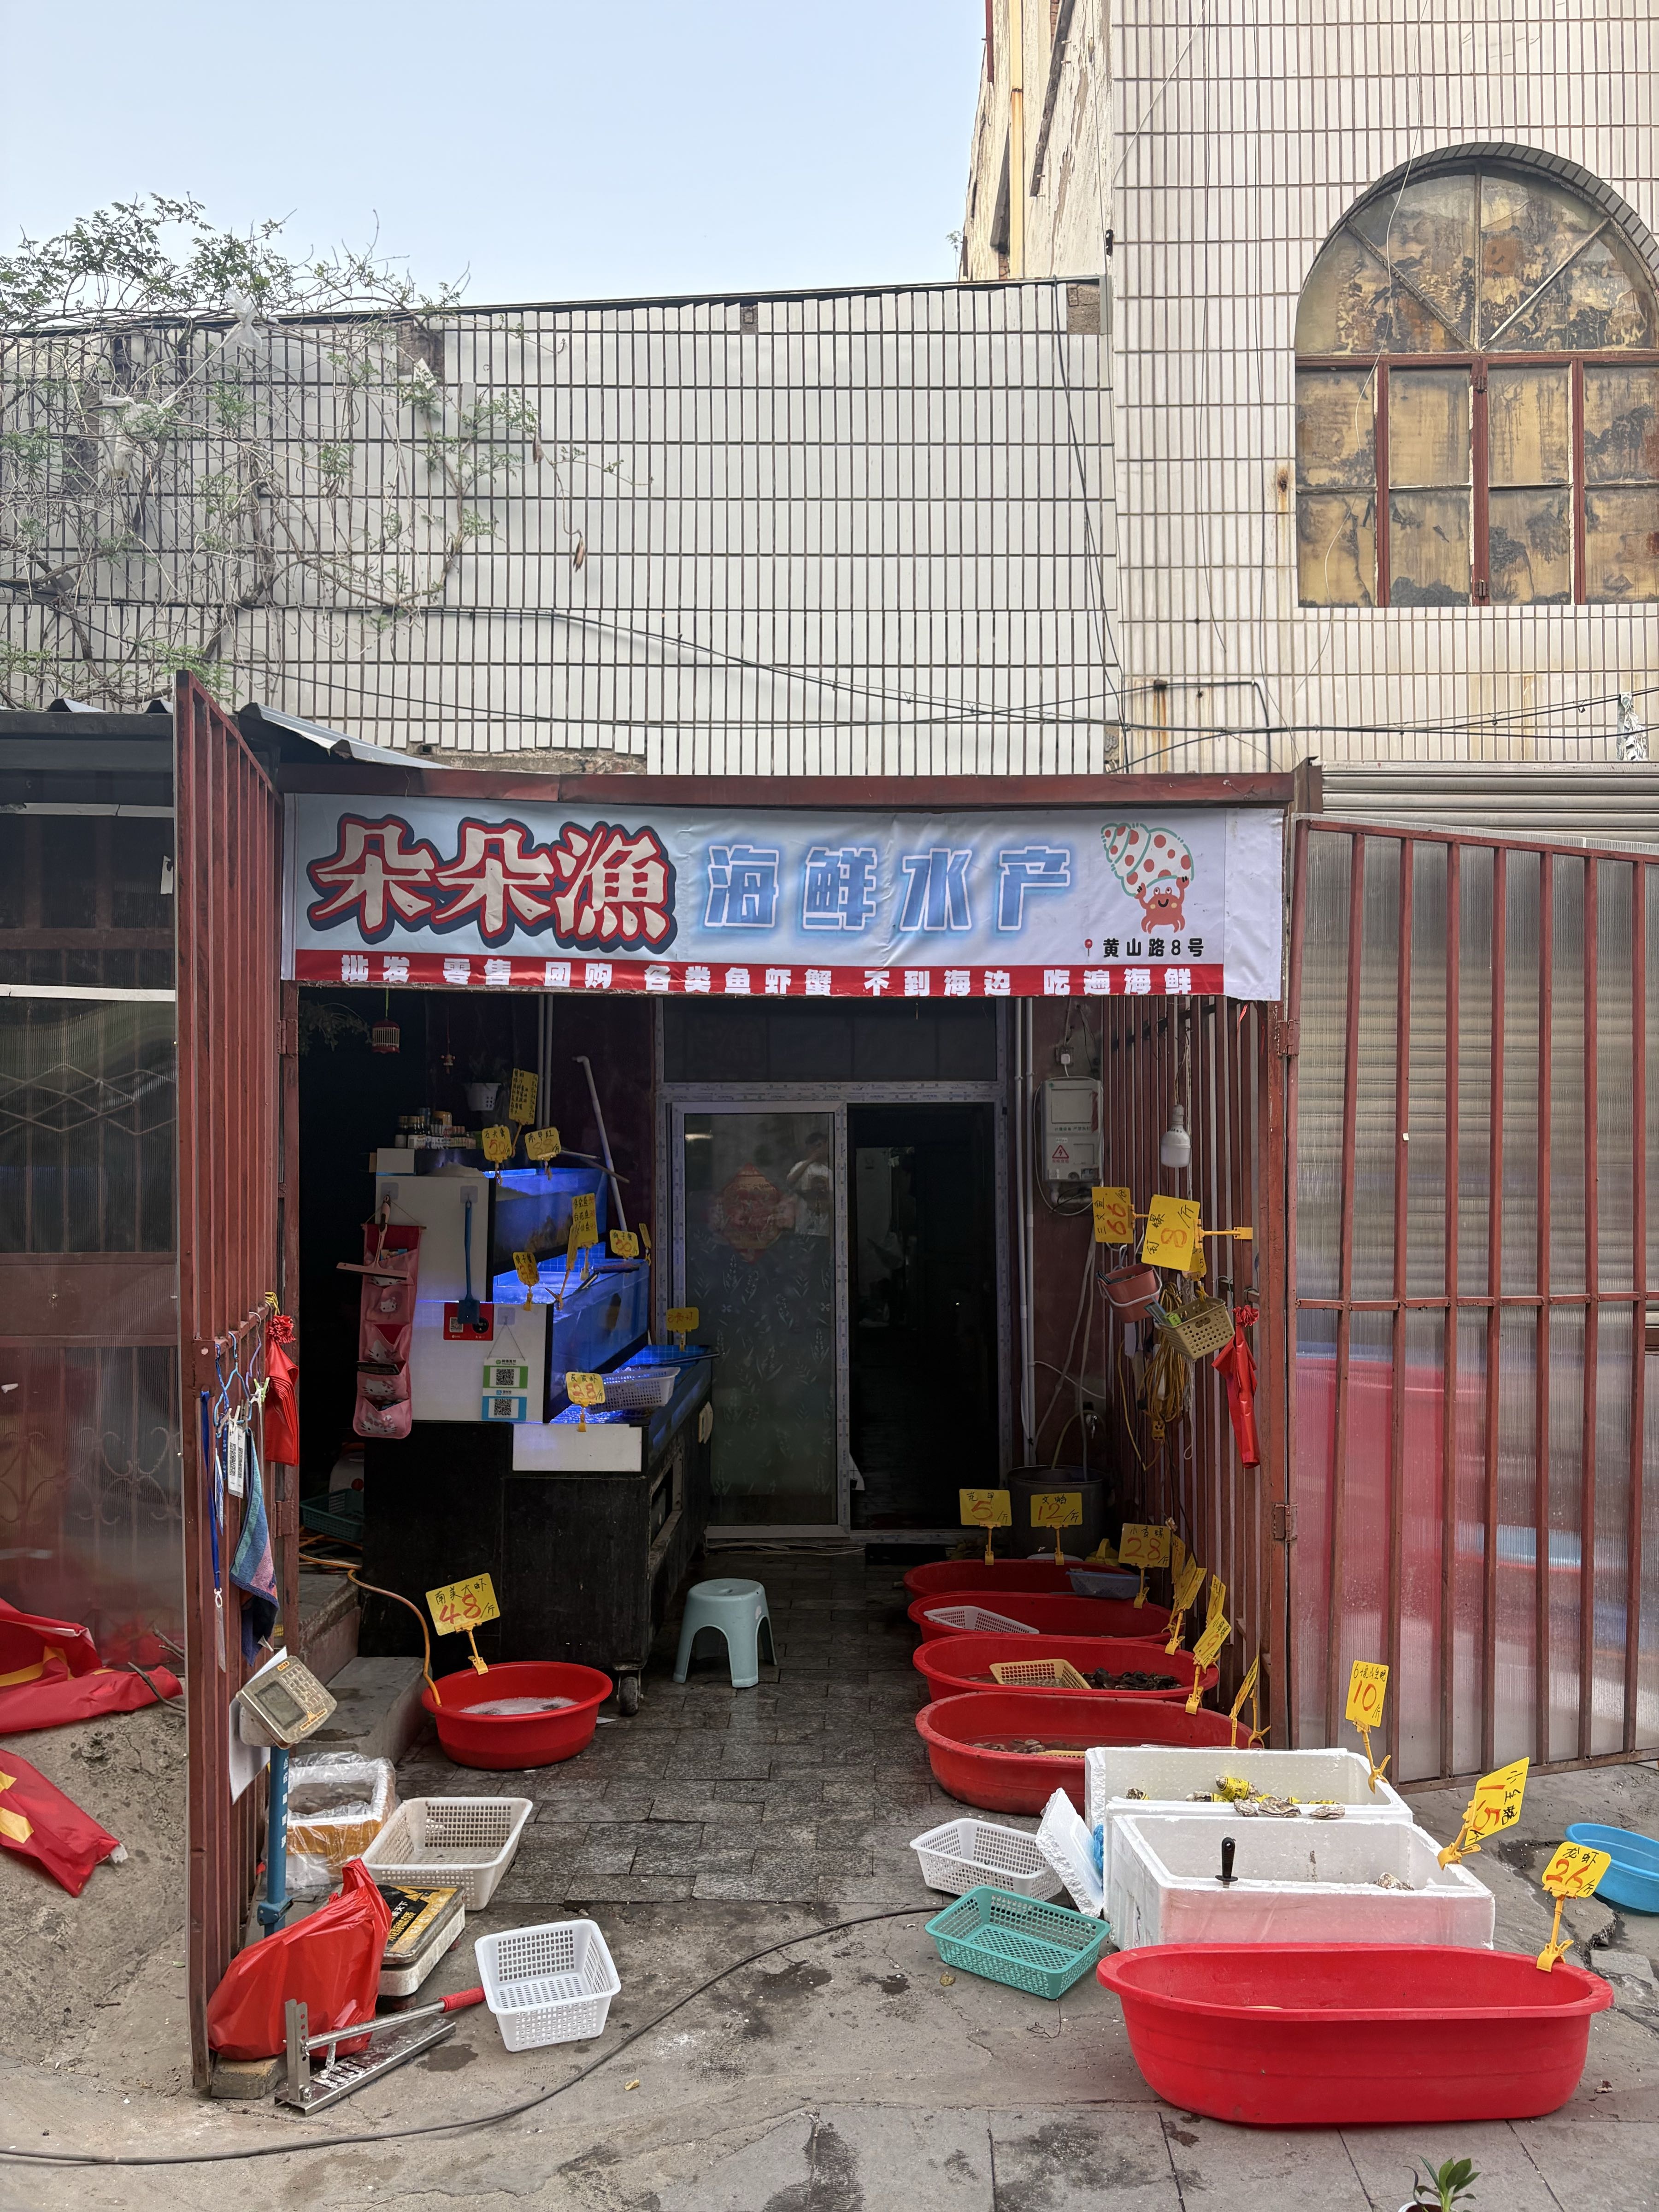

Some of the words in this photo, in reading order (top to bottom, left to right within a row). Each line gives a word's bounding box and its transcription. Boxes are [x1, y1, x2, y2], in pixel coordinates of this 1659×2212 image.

[308, 815, 676, 951] 朵朵漁
[705, 845, 1070, 931] 海鲜水产
[1103, 938, 1204, 958] 黄山路8号
[341, 954, 410, 983] 批发
[442, 958, 511, 986] 零售
[544, 962, 612, 989] 团购
[644, 965, 831, 996] 各类鱼虾蟹
[864, 970, 1011, 996] 不到海边
[1043, 968, 1192, 995] 吃遍海鲜
[435, 1578, 487, 1605] 南美大虾
[439, 1594, 495, 1624] 48/斤
[1501, 1770, 1524, 1825] 小生蚝
[1563, 1847, 1600, 1864] 龙虾
